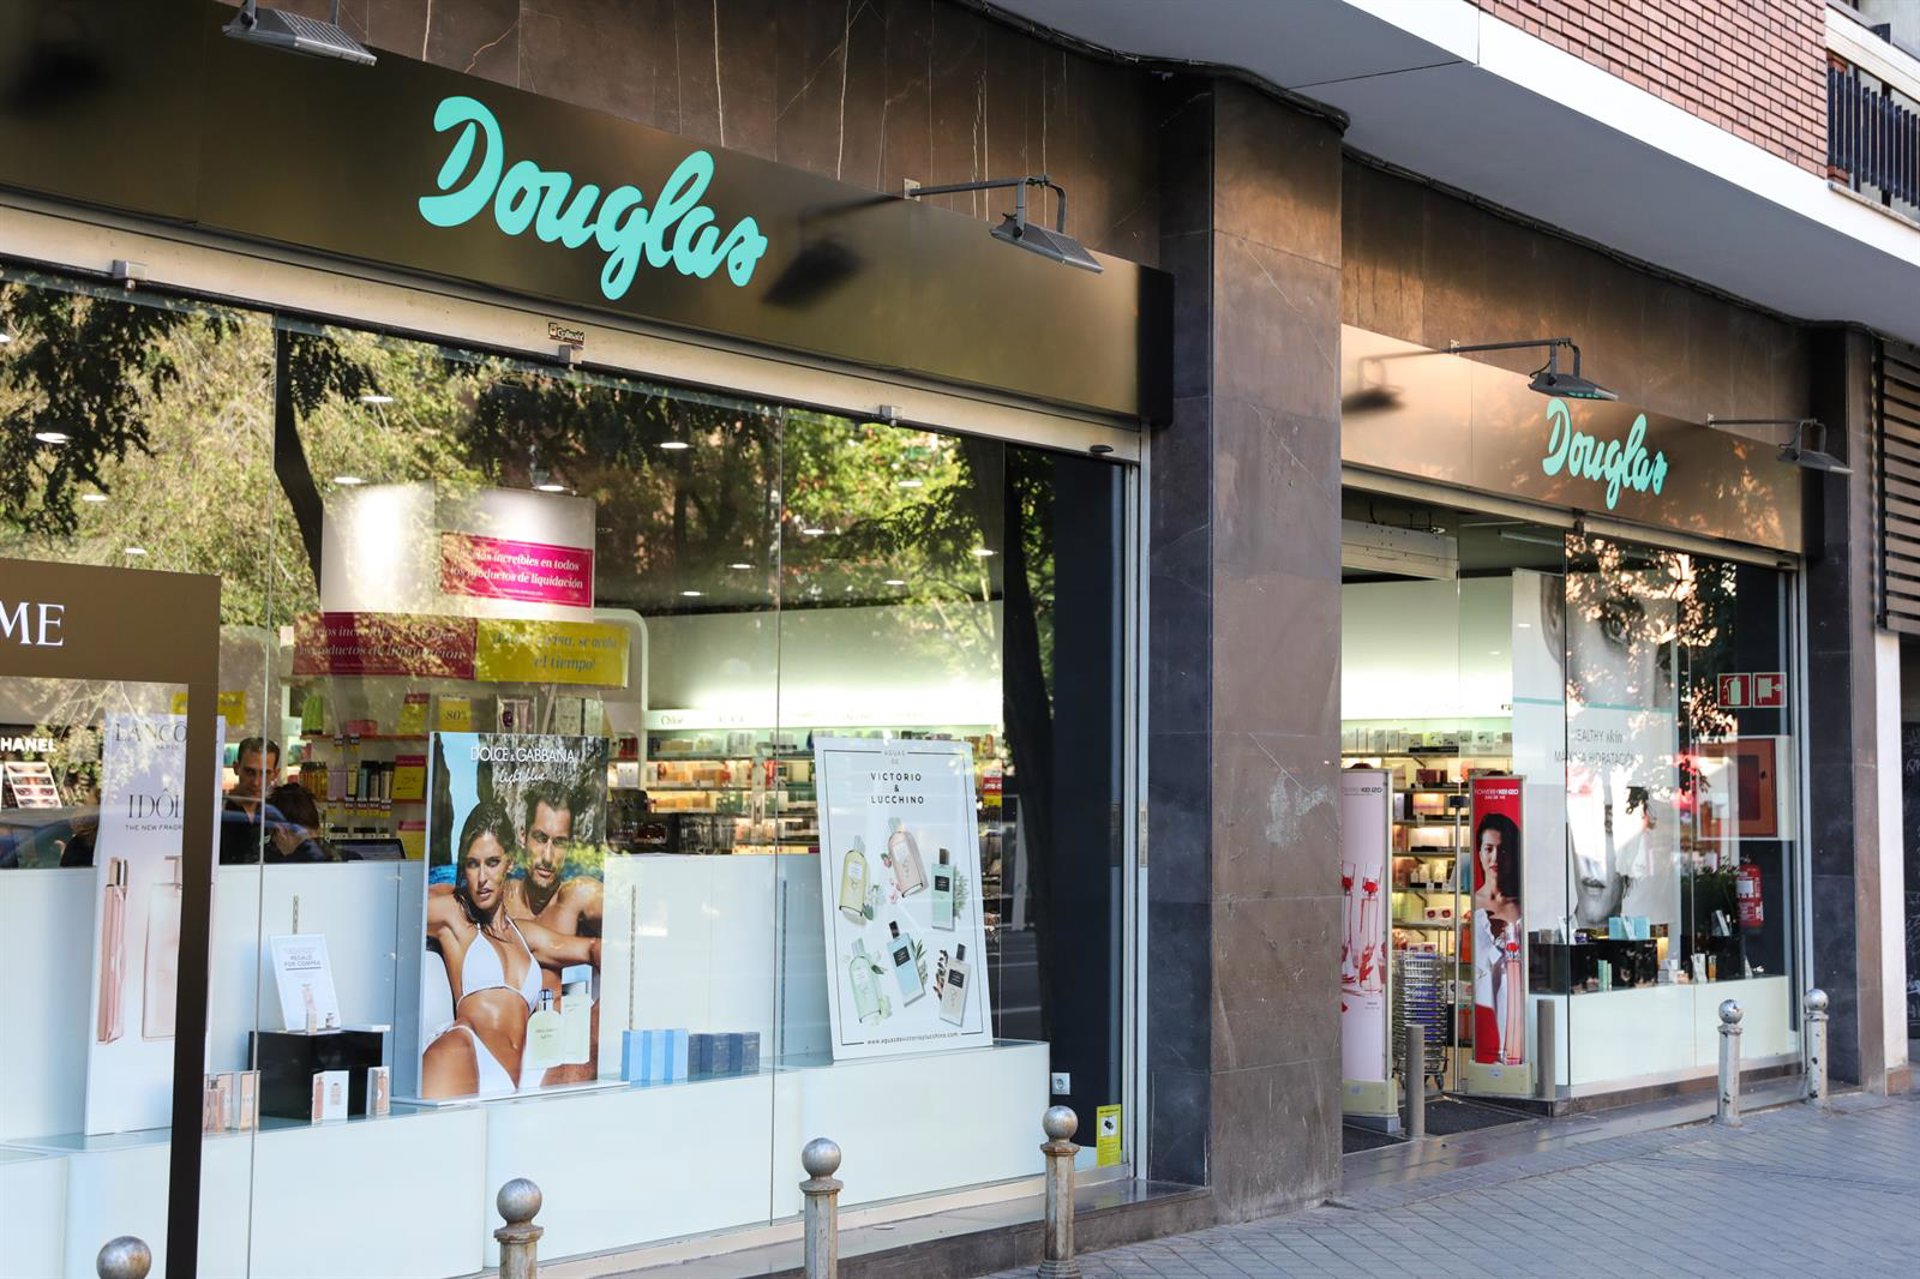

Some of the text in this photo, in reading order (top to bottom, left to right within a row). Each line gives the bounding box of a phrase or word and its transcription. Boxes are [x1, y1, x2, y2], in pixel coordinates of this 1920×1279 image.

[418, 96, 769, 301] Douglas
[1541, 397, 1669, 510] Douglas
[541, 558, 553, 568] en
[553, 557, 580, 571] todos
[517, 571, 530, 583] de
[530, 572, 583, 589] liquidación
[0, 601, 66, 647] ME
[470, 747, 509, 762] DOLCE
[516, 748, 576, 763] GABBANA
[870, 772, 922, 782] VICTORIO
[893, 784, 900, 793] &
[870, 795, 925, 805] LUCCHINO
